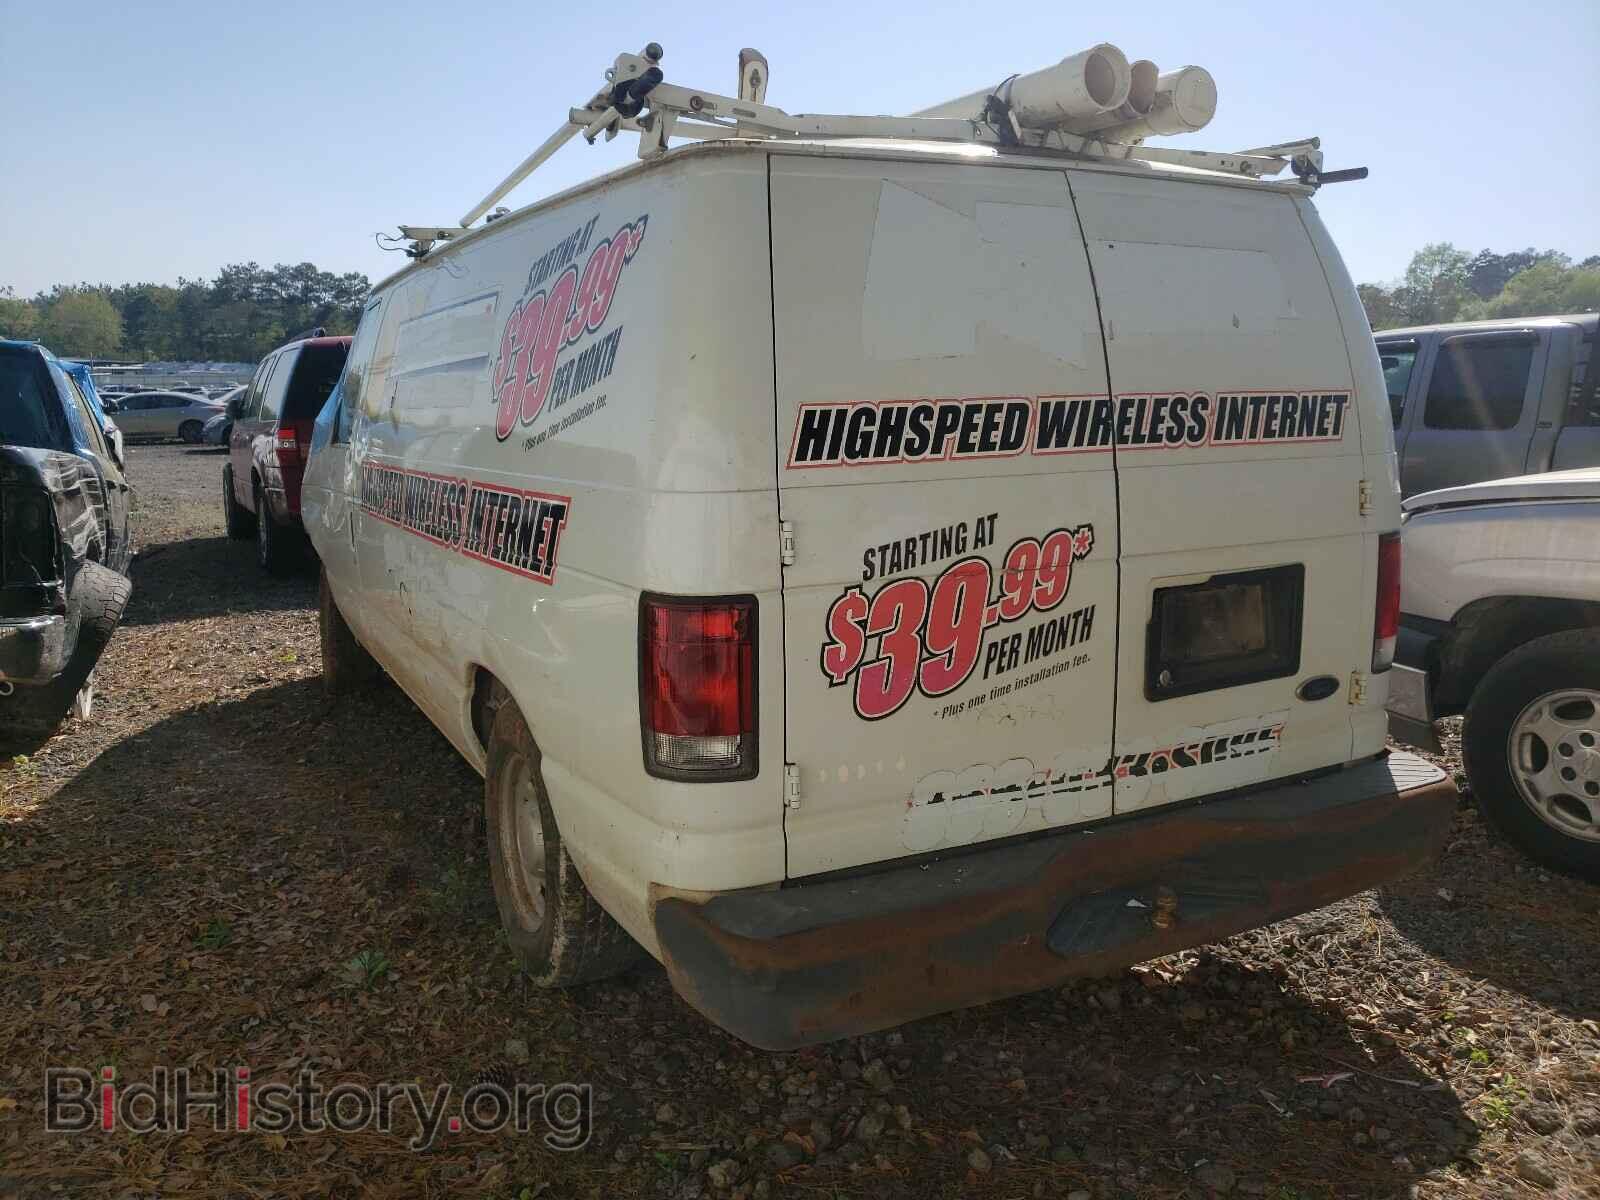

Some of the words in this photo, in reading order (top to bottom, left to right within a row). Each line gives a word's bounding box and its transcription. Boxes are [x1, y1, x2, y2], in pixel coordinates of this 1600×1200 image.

[523, 226, 582, 297] STARTING
[576, 212, 601, 258] AT
[548, 358, 576, 413] PER
[569, 325, 624, 400] MONTH
[794, 400, 1032, 463] HIGHSPEED
[1036, 396, 1210, 450] WIRELESS
[1212, 393, 1350, 442] INTERNET
[403, 473, 467, 548] WIRELESS
[463, 486, 568, 578] INTERNET
[862, 521, 968, 581] STARTING
[972, 512, 999, 552] AT
[967, 693, 987, 709] one
[989, 681, 1012, 701] time
[1014, 660, 1070, 692] installation
[1072, 652, 1091, 669] fee.
[982, 632, 1023, 681] PER
[1023, 604, 1097, 665] MONTH
